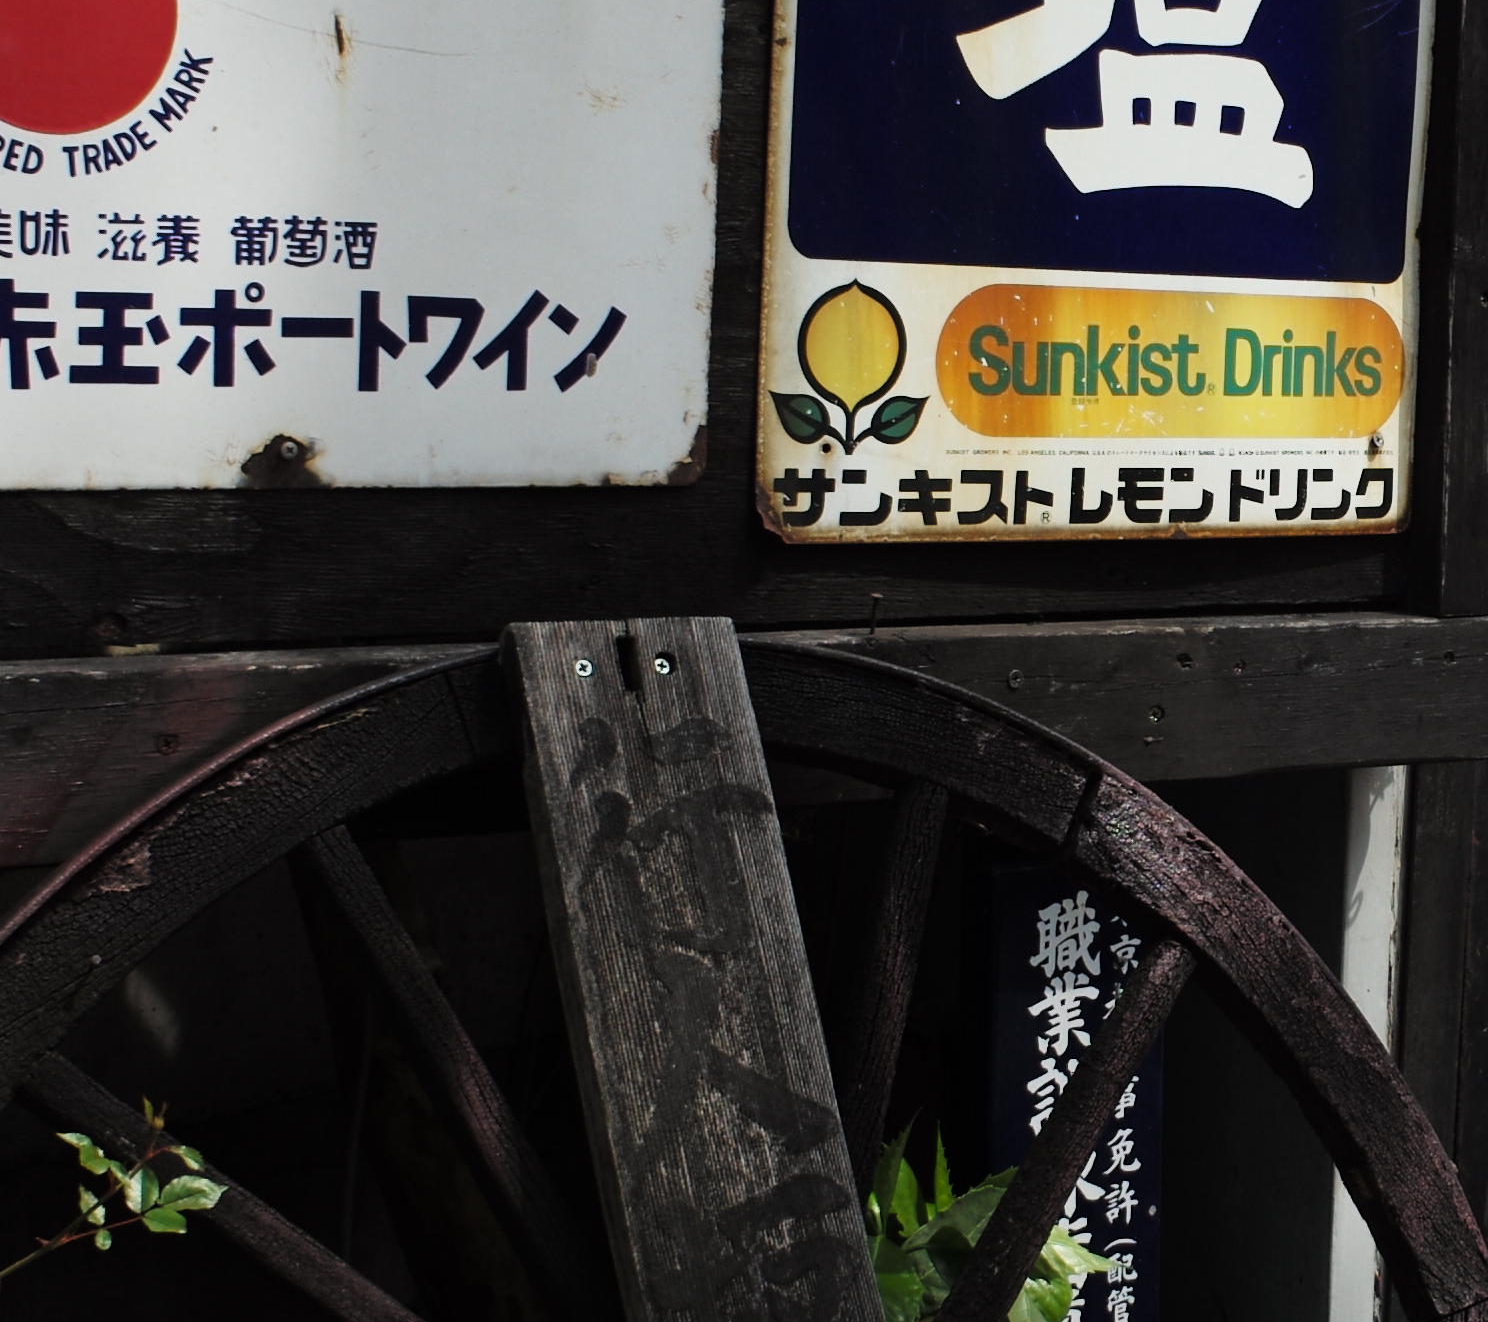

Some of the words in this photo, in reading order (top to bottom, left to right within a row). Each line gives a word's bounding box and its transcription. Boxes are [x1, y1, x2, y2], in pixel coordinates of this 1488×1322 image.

[61, 122, 159, 178] TRADE
[152, 48, 215, 135] MARK
[96, 212, 202, 266] 滋養
[230, 215, 380, 270] 葡萄酒
[968, 323, 1206, 397] Sunkist
[1221, 329, 1383, 400] Drinks
